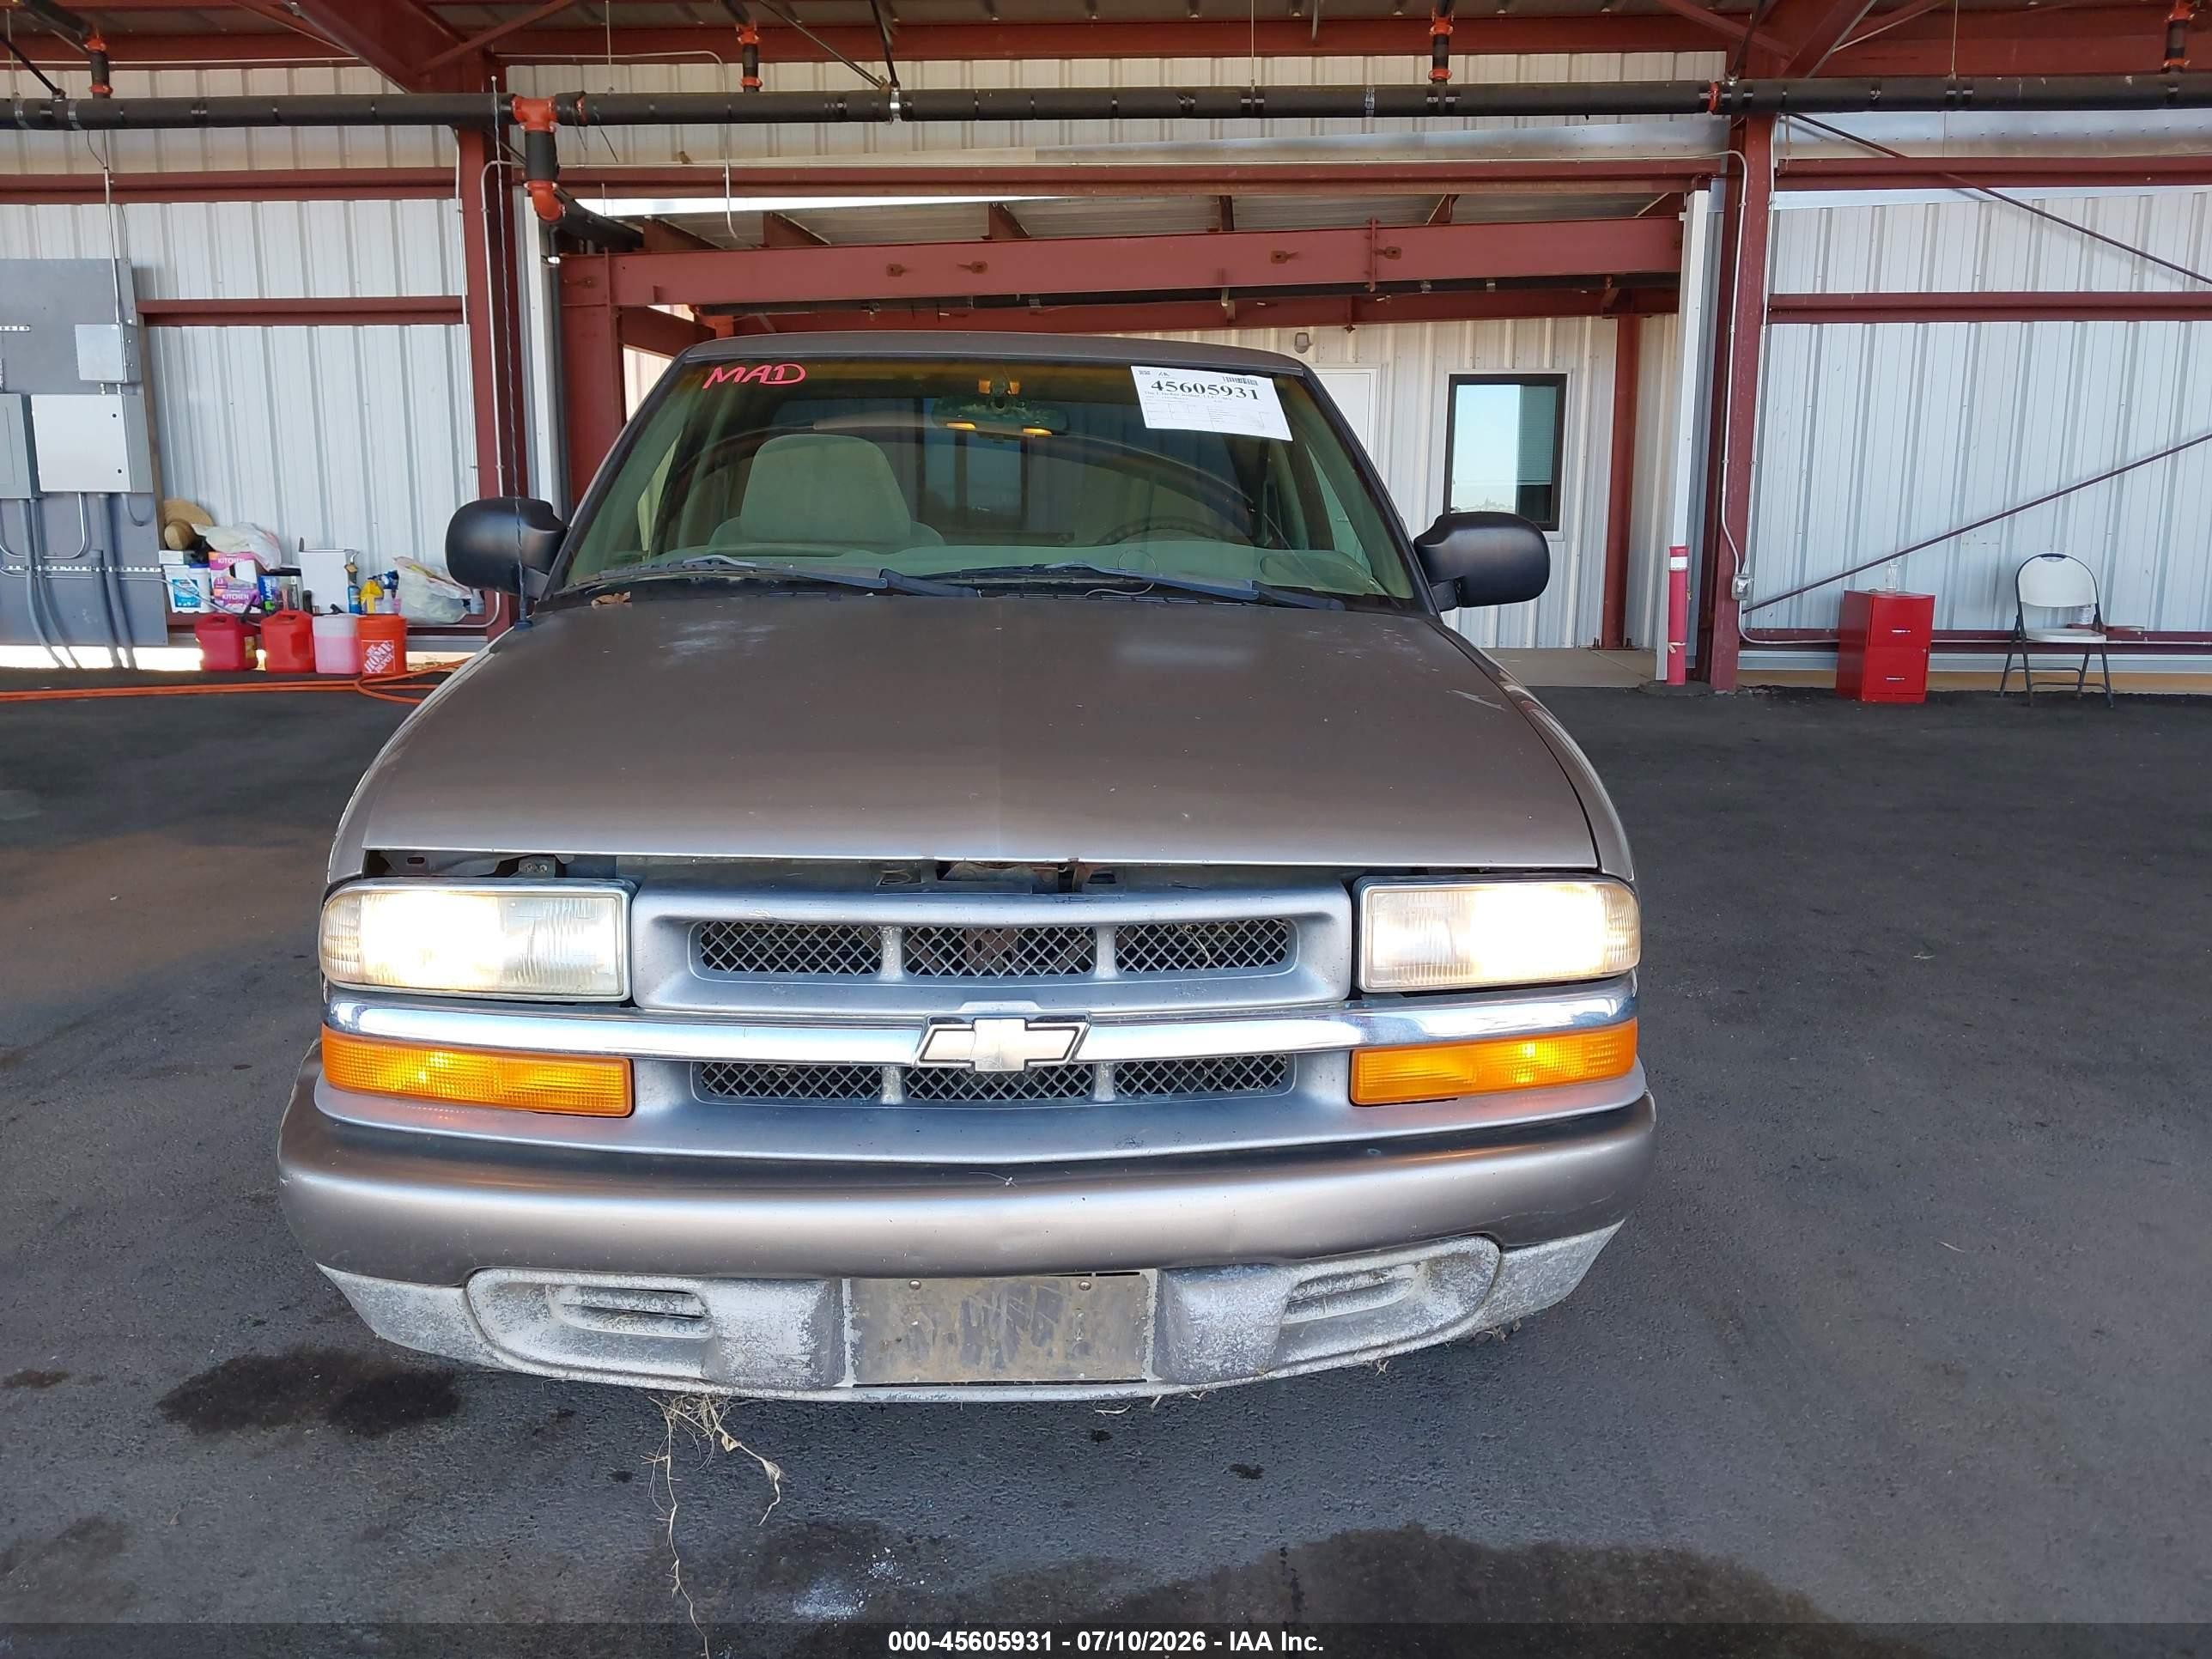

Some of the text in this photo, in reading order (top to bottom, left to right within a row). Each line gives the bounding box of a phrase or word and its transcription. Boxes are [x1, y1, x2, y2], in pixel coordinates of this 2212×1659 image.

[702, 363, 806, 390] MAD
[1151, 380, 1260, 400] 45605931
[364, 641, 392, 673] HOME
